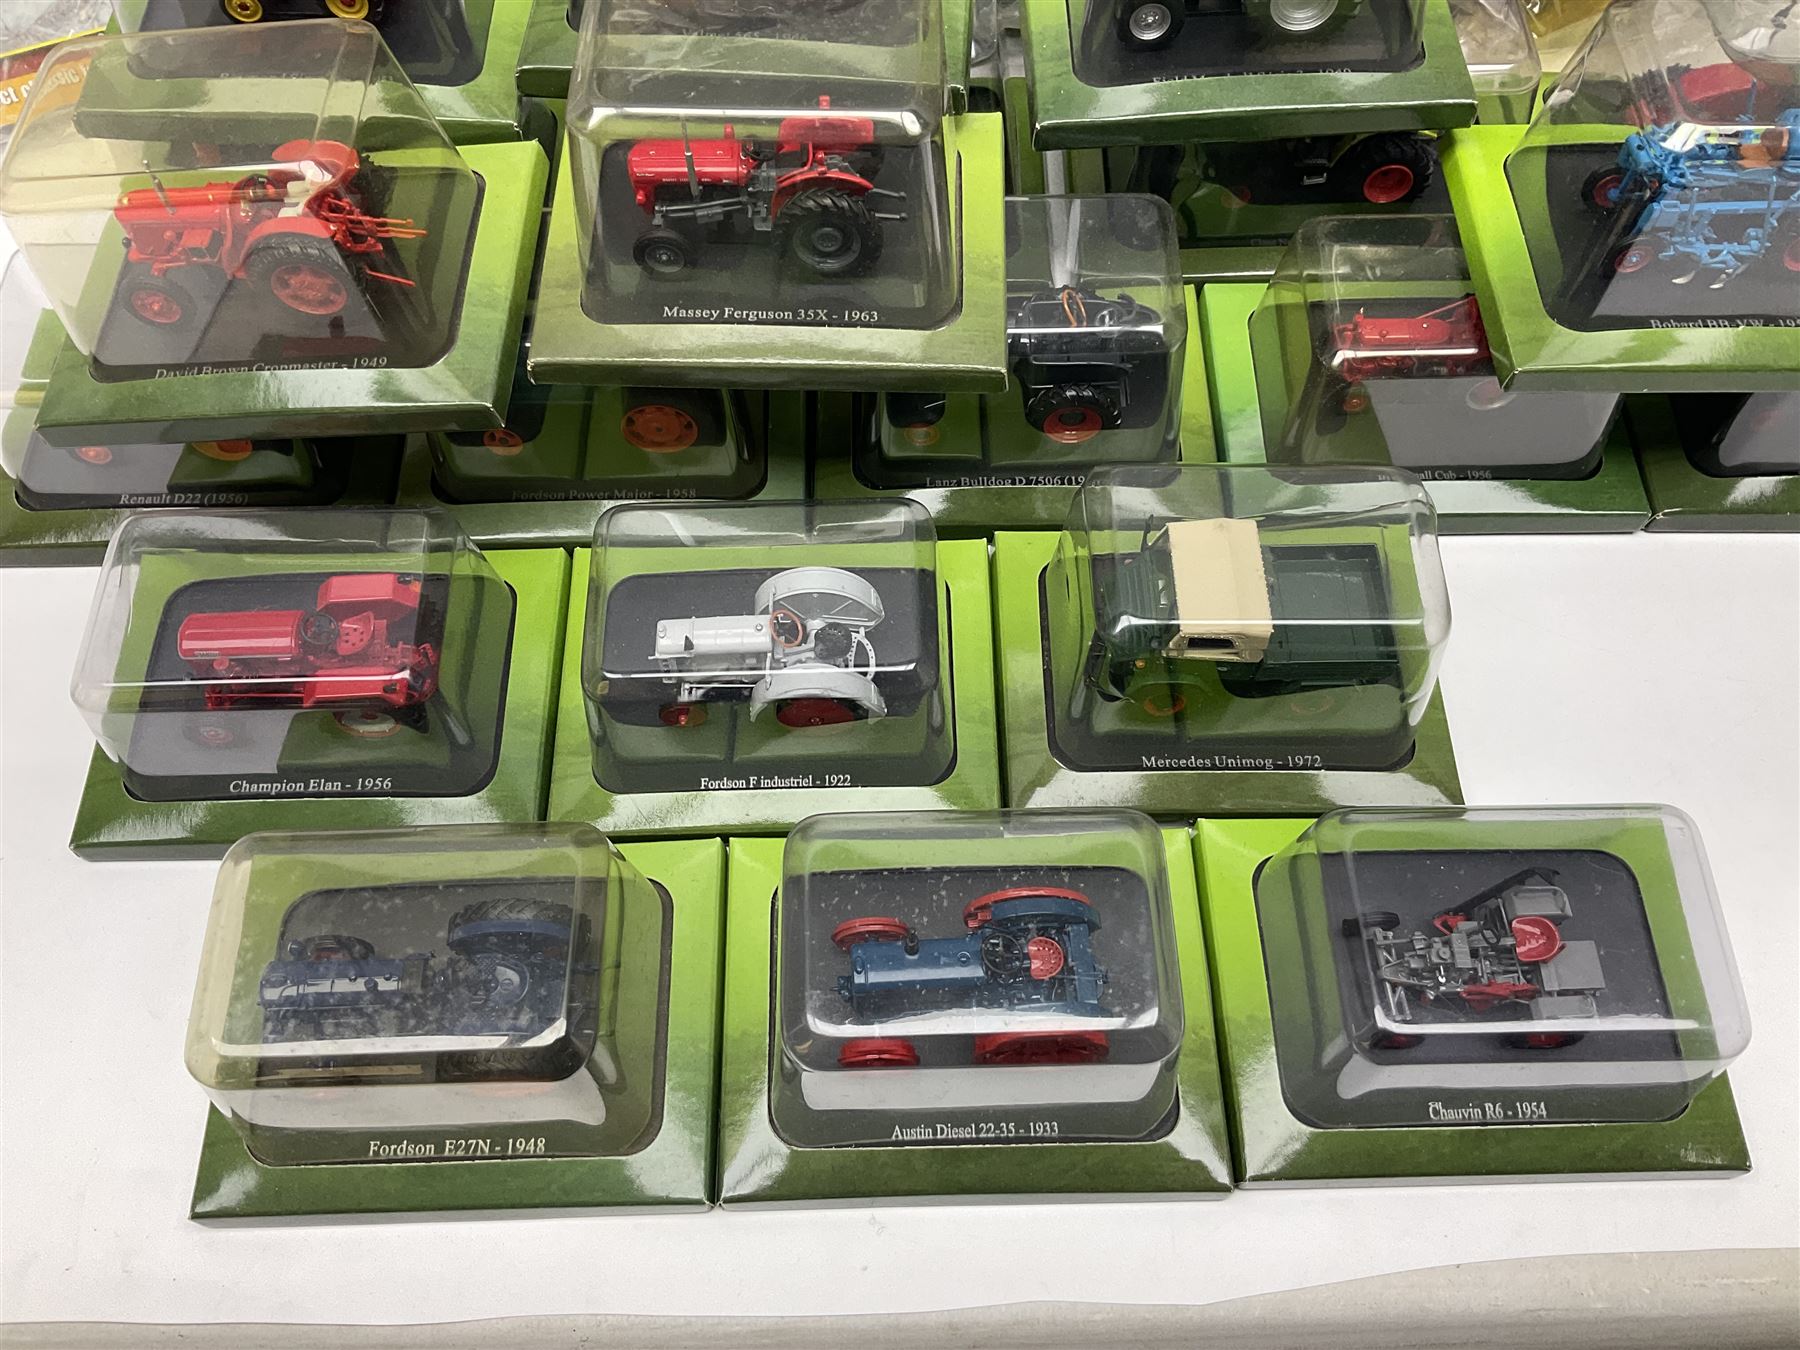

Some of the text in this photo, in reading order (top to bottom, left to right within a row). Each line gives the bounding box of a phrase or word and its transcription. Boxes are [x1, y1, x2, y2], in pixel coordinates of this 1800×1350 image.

[662, 306, 720, 320] Massey
[723, 307, 793, 321] Ferguson
[797, 309, 828, 321] 35X
[844, 310, 878, 322] 1963
[155, 367, 198, 379] David
[200, 366, 248, 376] Brown
[352, 357, 388, 369] 1949
[926, 477, 957, 487] Lanz
[960, 476, 1011, 487] Bulldog
[1015, 476, 1026, 486] D
[1029, 476, 1062, 486] 7506
[1435, 470, 1457, 480] Cub
[1467, 470, 1492, 480] 1956
[120, 493, 249, 505] Renault D22 (1956)
[512, 489, 565, 500] Fordson
[569, 489, 609, 499] Power
[614, 489, 653, 499] Major
[666, 488, 697, 498] 1958
[1141, 755, 1211, 768] Mercedes
[1214, 755, 1274, 770] Unimog
[1287, 755, 1322, 768] 1972
[229, 779, 304, 795] Champion
[308, 778, 342, 791] Elan
[356, 777, 392, 790] 1956
[700, 777, 746, 789] Fordson
[749, 776, 758, 788] F
[760, 774, 813, 788] industriel
[824, 774, 851, 787] 1922
[1428, 1101, 1482, 1120] Chauvin
[1484, 1102, 1504, 1119] R6
[1516, 1101, 1547, 1119] 1954
[891, 1124, 933, 1140] Austin
[936, 1123, 976, 1139] Diesel
[979, 1122, 1015, 1137] 22-35
[1029, 1121, 1059, 1137] 1933
[369, 1139, 435, 1157] Fordson
[444, 1138, 491, 1156] E27N
[507, 1137, 546, 1155] 1948
